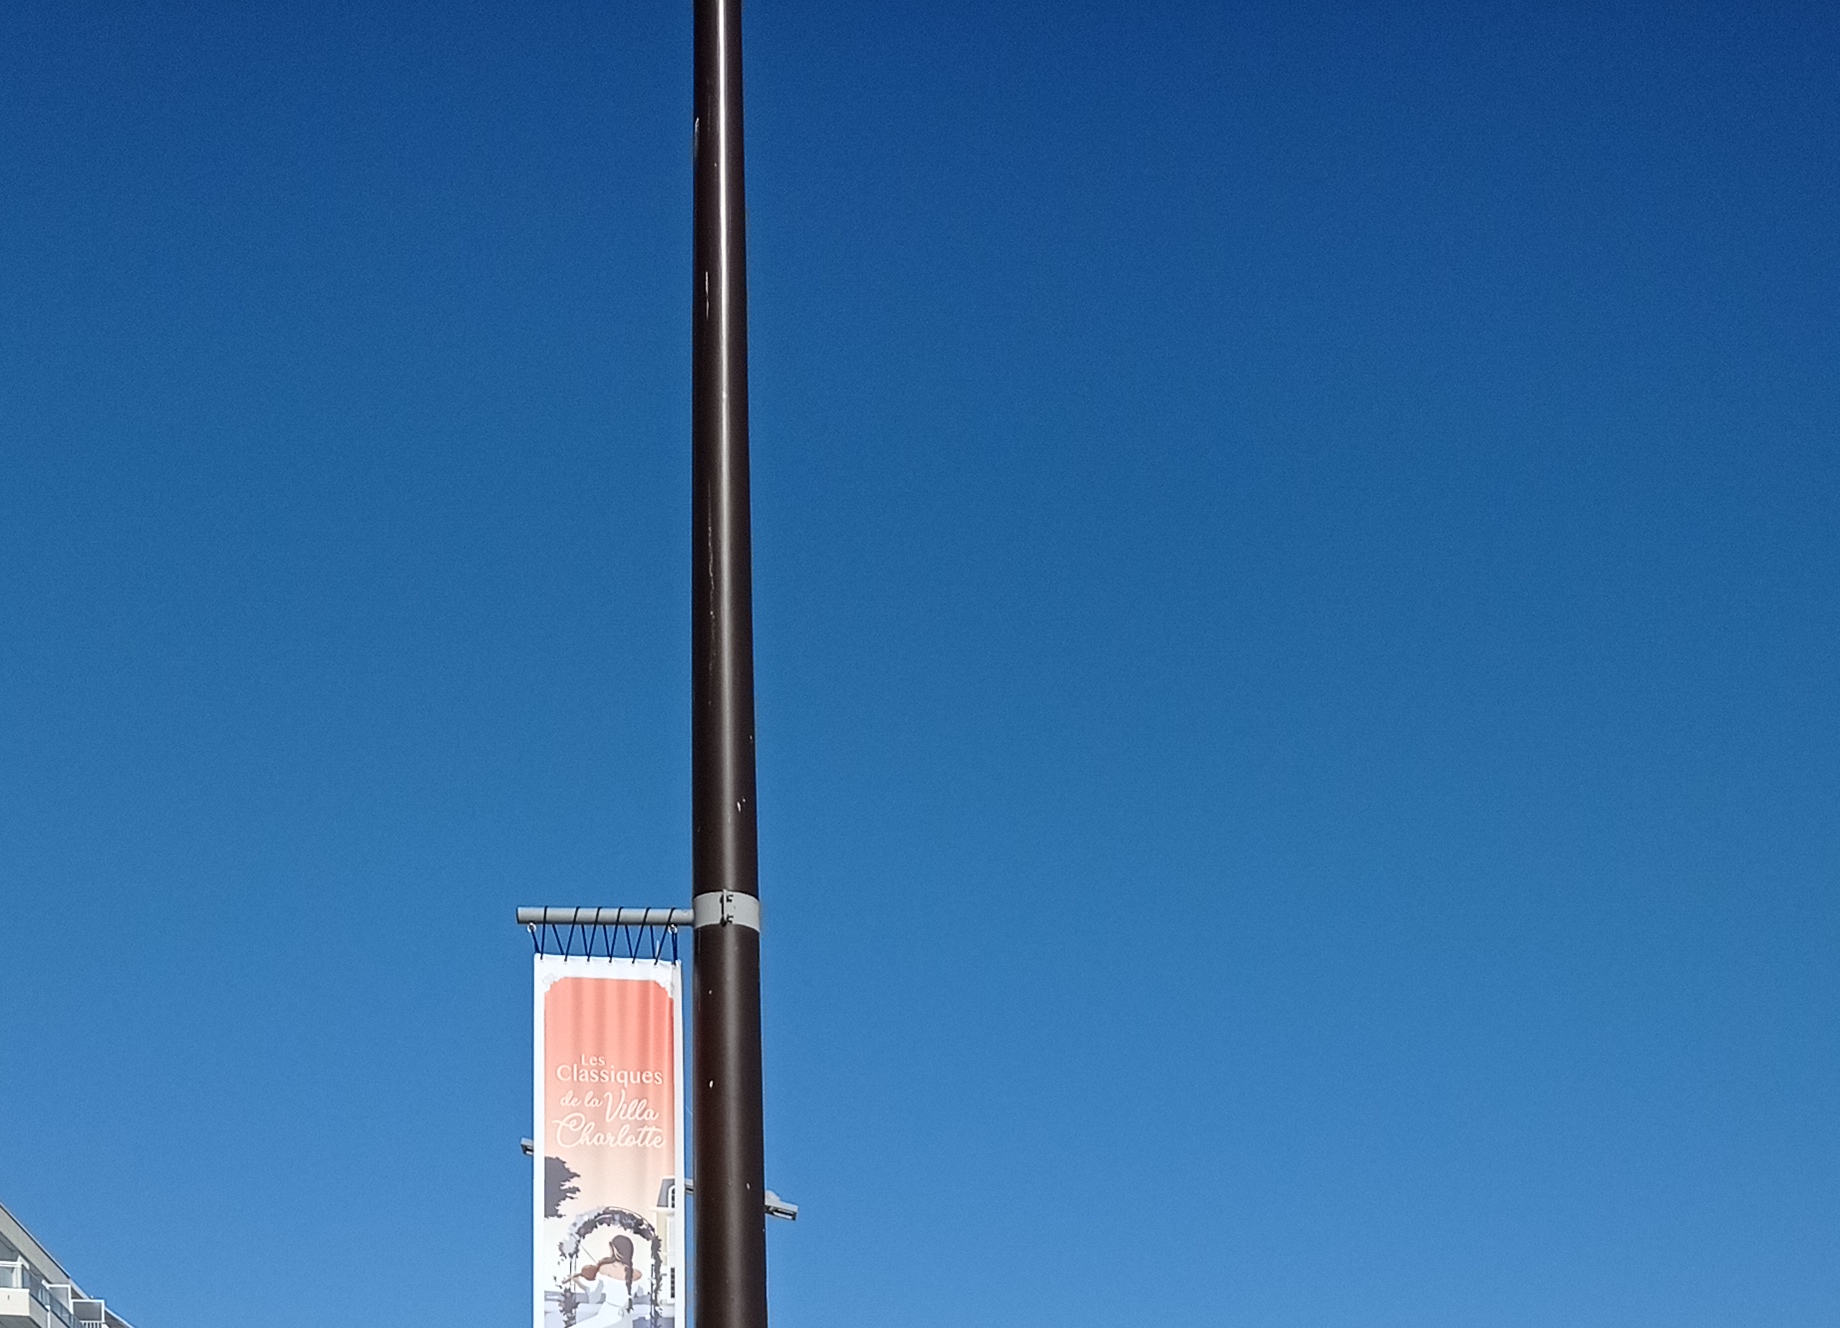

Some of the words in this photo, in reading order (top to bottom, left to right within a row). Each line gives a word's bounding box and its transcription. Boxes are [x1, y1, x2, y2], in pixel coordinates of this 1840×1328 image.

[580, 1053, 606, 1066] Les
[556, 1063, 664, 1087] Classiques
[560, 1090, 580, 1106] de
[584, 1091, 603, 1107] la
[604, 1089, 659, 1123] Villa
[552, 1112, 666, 1148] Charlotte
